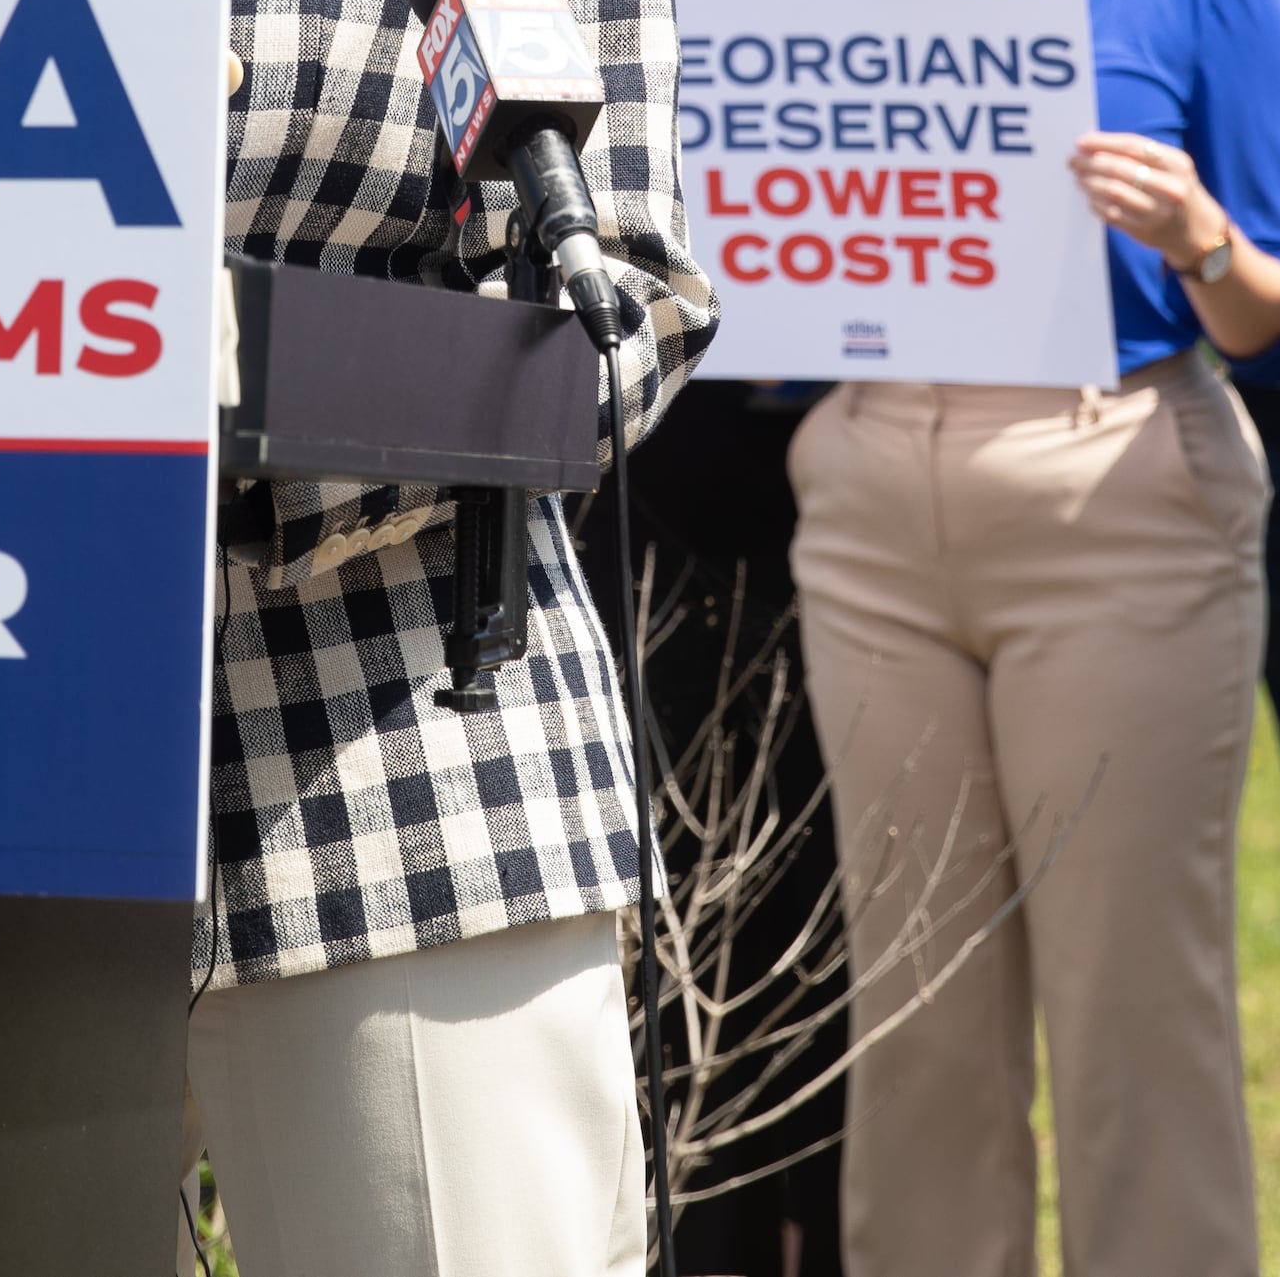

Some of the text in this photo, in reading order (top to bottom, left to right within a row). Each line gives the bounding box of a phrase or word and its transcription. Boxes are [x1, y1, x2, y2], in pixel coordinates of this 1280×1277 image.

[498, 13, 569, 74] 5
[680, 35, 1076, 87] EORGIANS
[440, 34, 476, 127] 5
[456, 91, 492, 167] NEWS
[706, 168, 1000, 219] LOWER
[720, 233, 997, 288] COSTS
